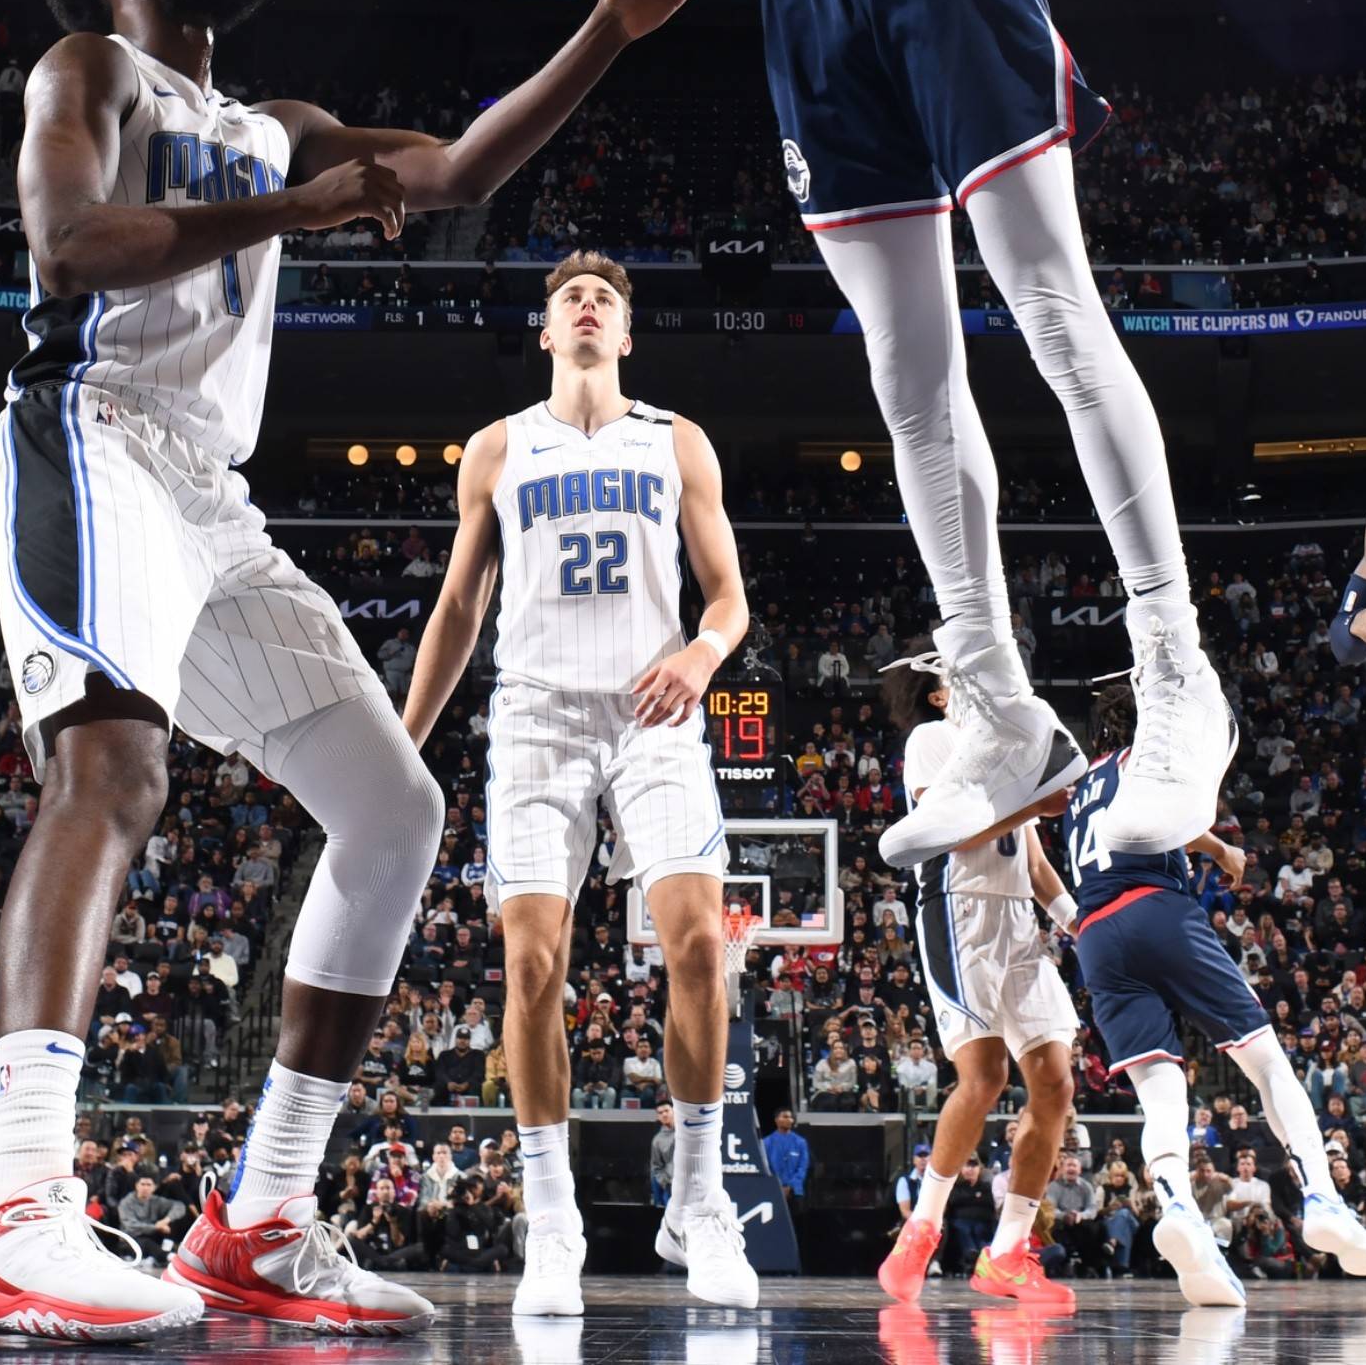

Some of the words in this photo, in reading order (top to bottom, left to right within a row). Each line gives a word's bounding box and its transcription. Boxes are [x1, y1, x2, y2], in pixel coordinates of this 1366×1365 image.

[709, 240, 765, 254] KIA
[295, 312, 356, 324] NETWORK
[385, 312, 404, 323] FLS:
[416, 311, 425, 326] 1
[446, 312, 465, 324] TOL:
[473, 311, 484, 327] 4
[654, 313, 682, 328] 4TH
[713, 311, 766, 331] 10:30
[987, 316, 1006, 327] TOL:
[1123, 315, 1170, 332] WATCH
[1173, 315, 1200, 332] THE
[1201, 314, 1268, 332] CLIPPERS
[1269, 313, 1289, 329] ON
[517, 468, 665, 533] MAGIC
[560, 530, 628, 596] 22
[339, 599, 420, 619] KIA
[709, 692, 769, 716] 10:29
[724, 717, 766, 760] 19
[716, 767, 775, 780] TISSOT
[1068, 807, 1113, 888] 14
